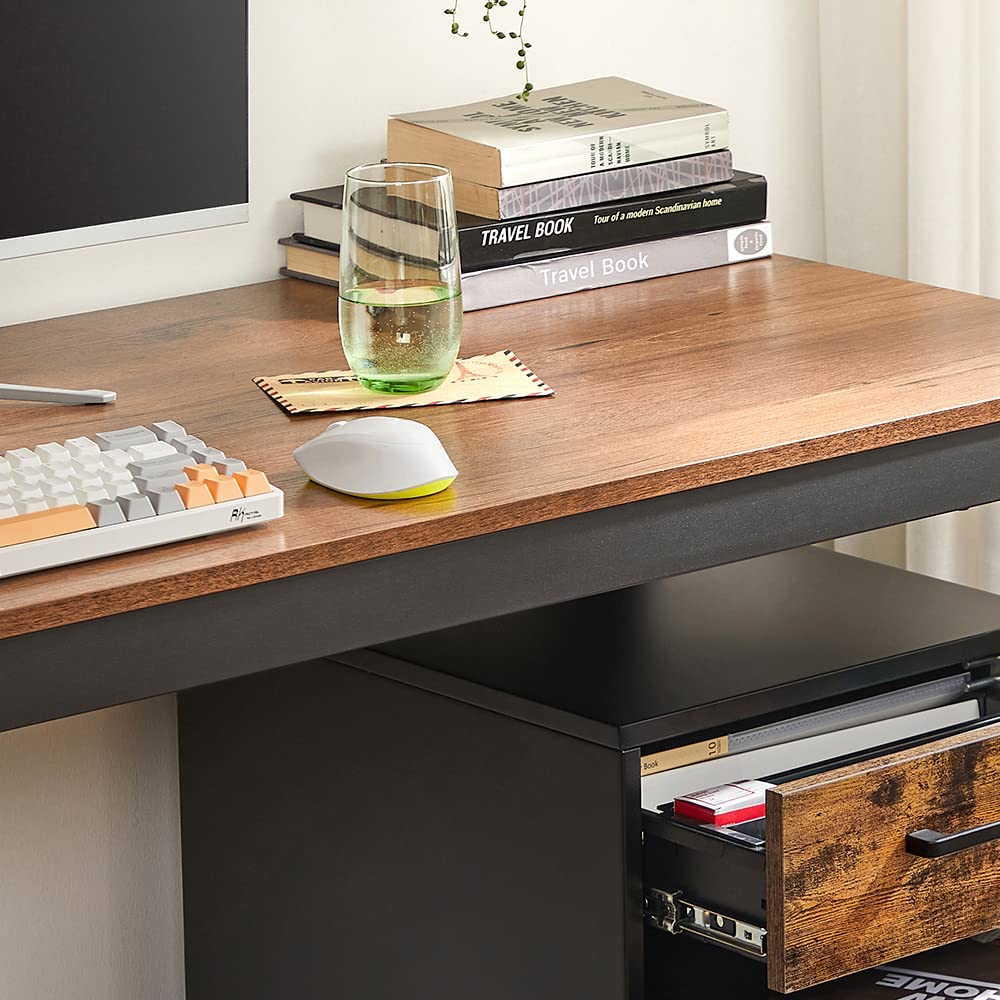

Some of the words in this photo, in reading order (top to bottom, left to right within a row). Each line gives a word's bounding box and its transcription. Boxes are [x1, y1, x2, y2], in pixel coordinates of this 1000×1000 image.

[593, 215, 610, 225] Tour
[611, 211, 620, 222] of
[626, 208, 654, 220] modern
[655, 200, 702, 215] Scandinavian
[702, 198, 723, 208] home
[481, 224, 531, 246] TRAVEL
[535, 217, 574, 238] BOOK
[540, 260, 594, 287] Travel
[602, 251, 649, 276] Book
[708, 742, 717, 756] 10
[643, 760, 659, 770] Book
